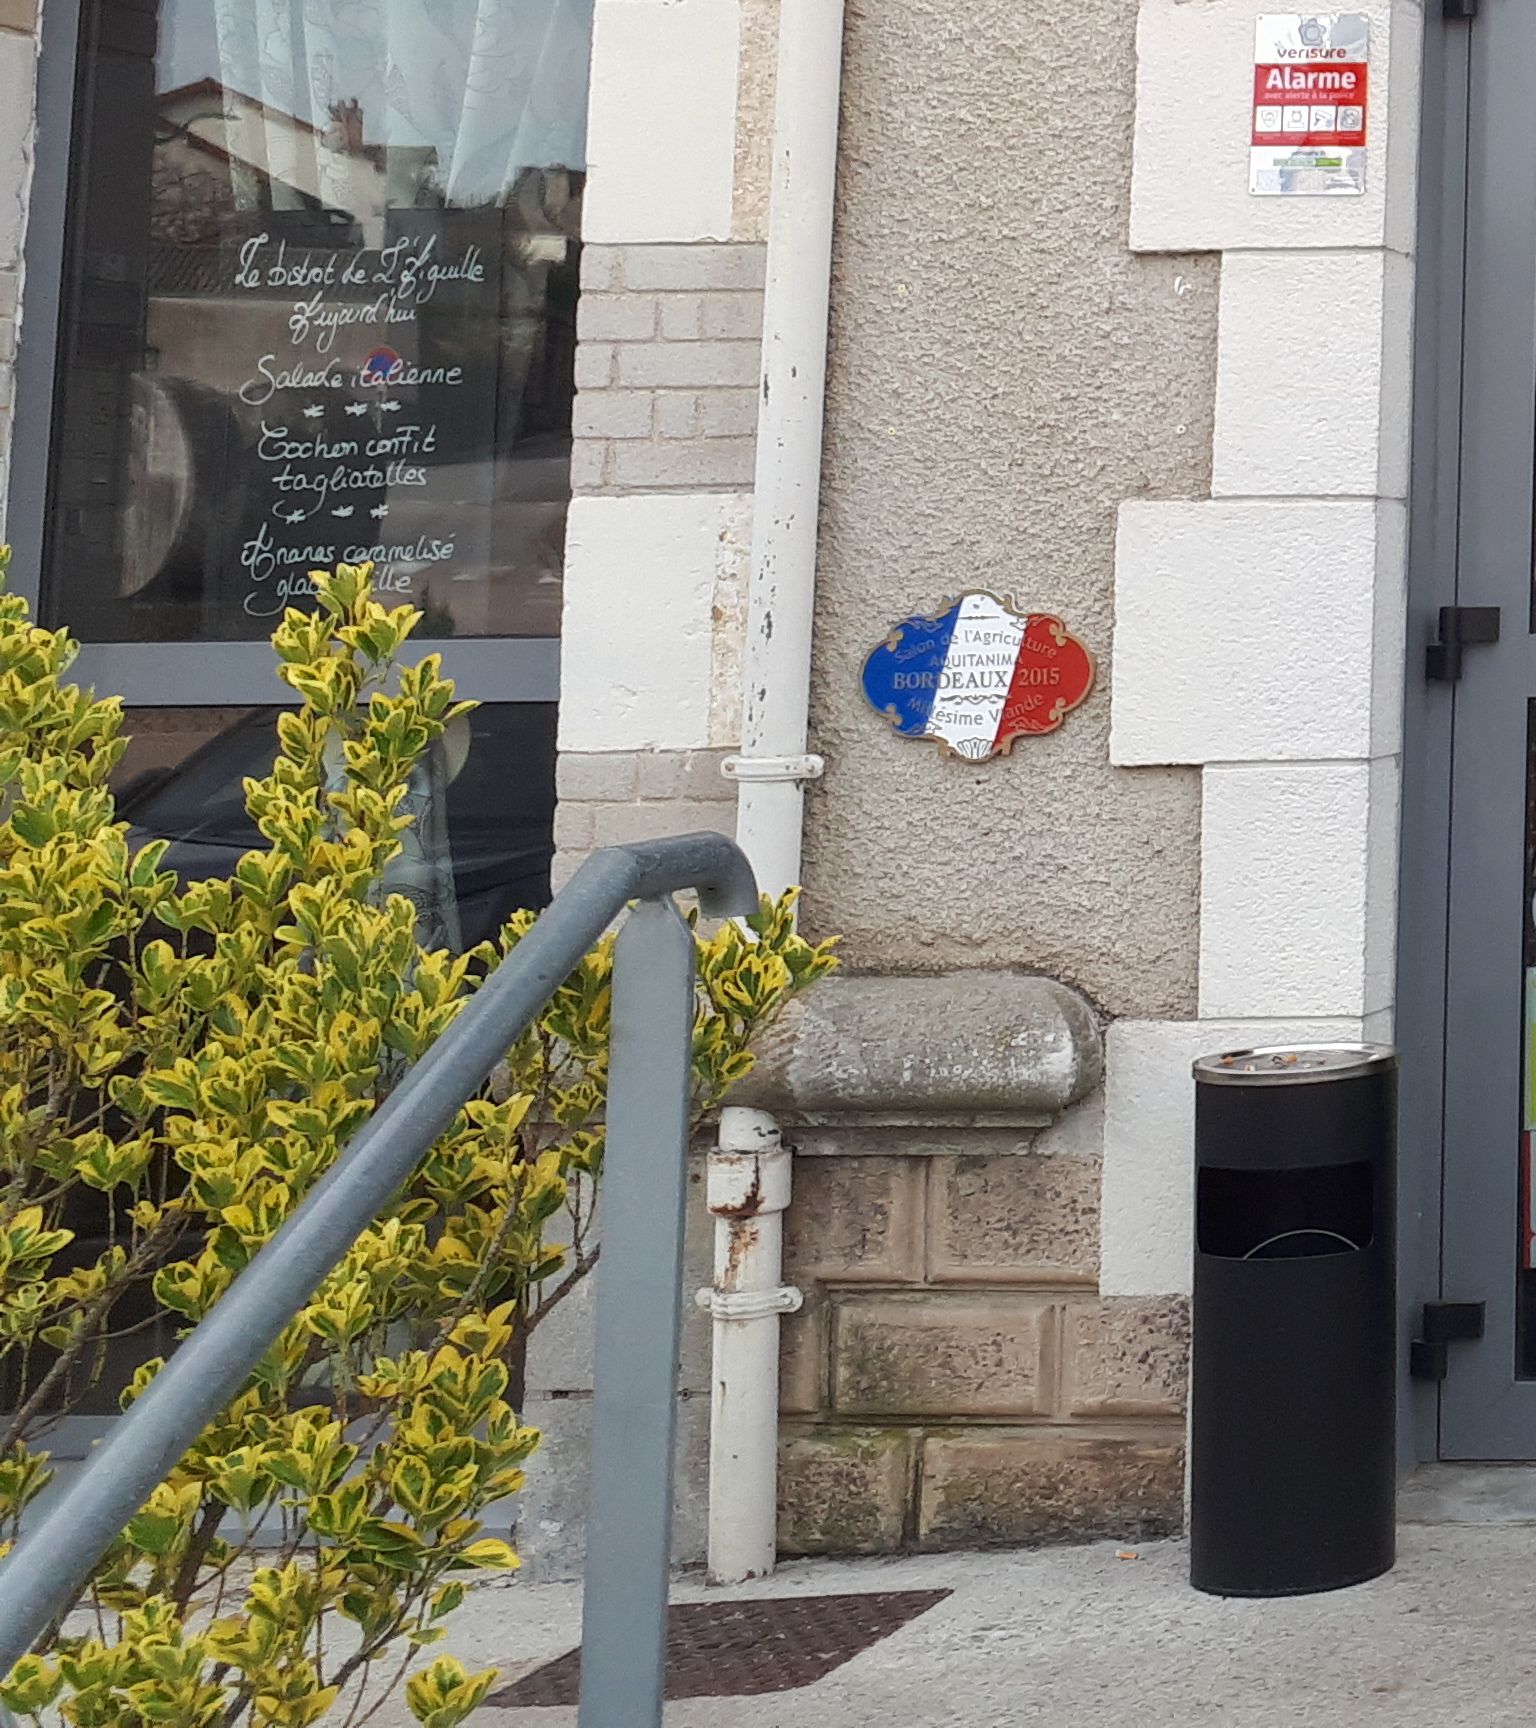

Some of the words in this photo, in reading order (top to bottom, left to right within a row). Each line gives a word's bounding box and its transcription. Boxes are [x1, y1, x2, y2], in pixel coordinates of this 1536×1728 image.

[1276, 47, 1348, 59] verisure
[1266, 66, 1356, 90] Alarme
[235, 232, 269, 288] Le
[289, 287, 417, 354] Aujourd'hui
[239, 354, 343, 406] Salade
[351, 357, 464, 389] italienne
[257, 421, 359, 461] Cochon
[272, 458, 428, 519] tagliatelles
[241, 522, 336, 582] Ananas
[342, 531, 457, 564] caramelisé
[244, 572, 322, 616] glac
[893, 637, 936, 664] Salon
[940, 630, 959, 646] de
[964, 629, 1058, 660] l'Agriculture
[929, 653, 1024, 669] AQUITANIMA
[892, 670, 1010, 690] BORDEAUX
[1018, 667, 1061, 687] 2015
[906, 695, 984, 726] Millésime
[988, 692, 1045, 724] Viande
